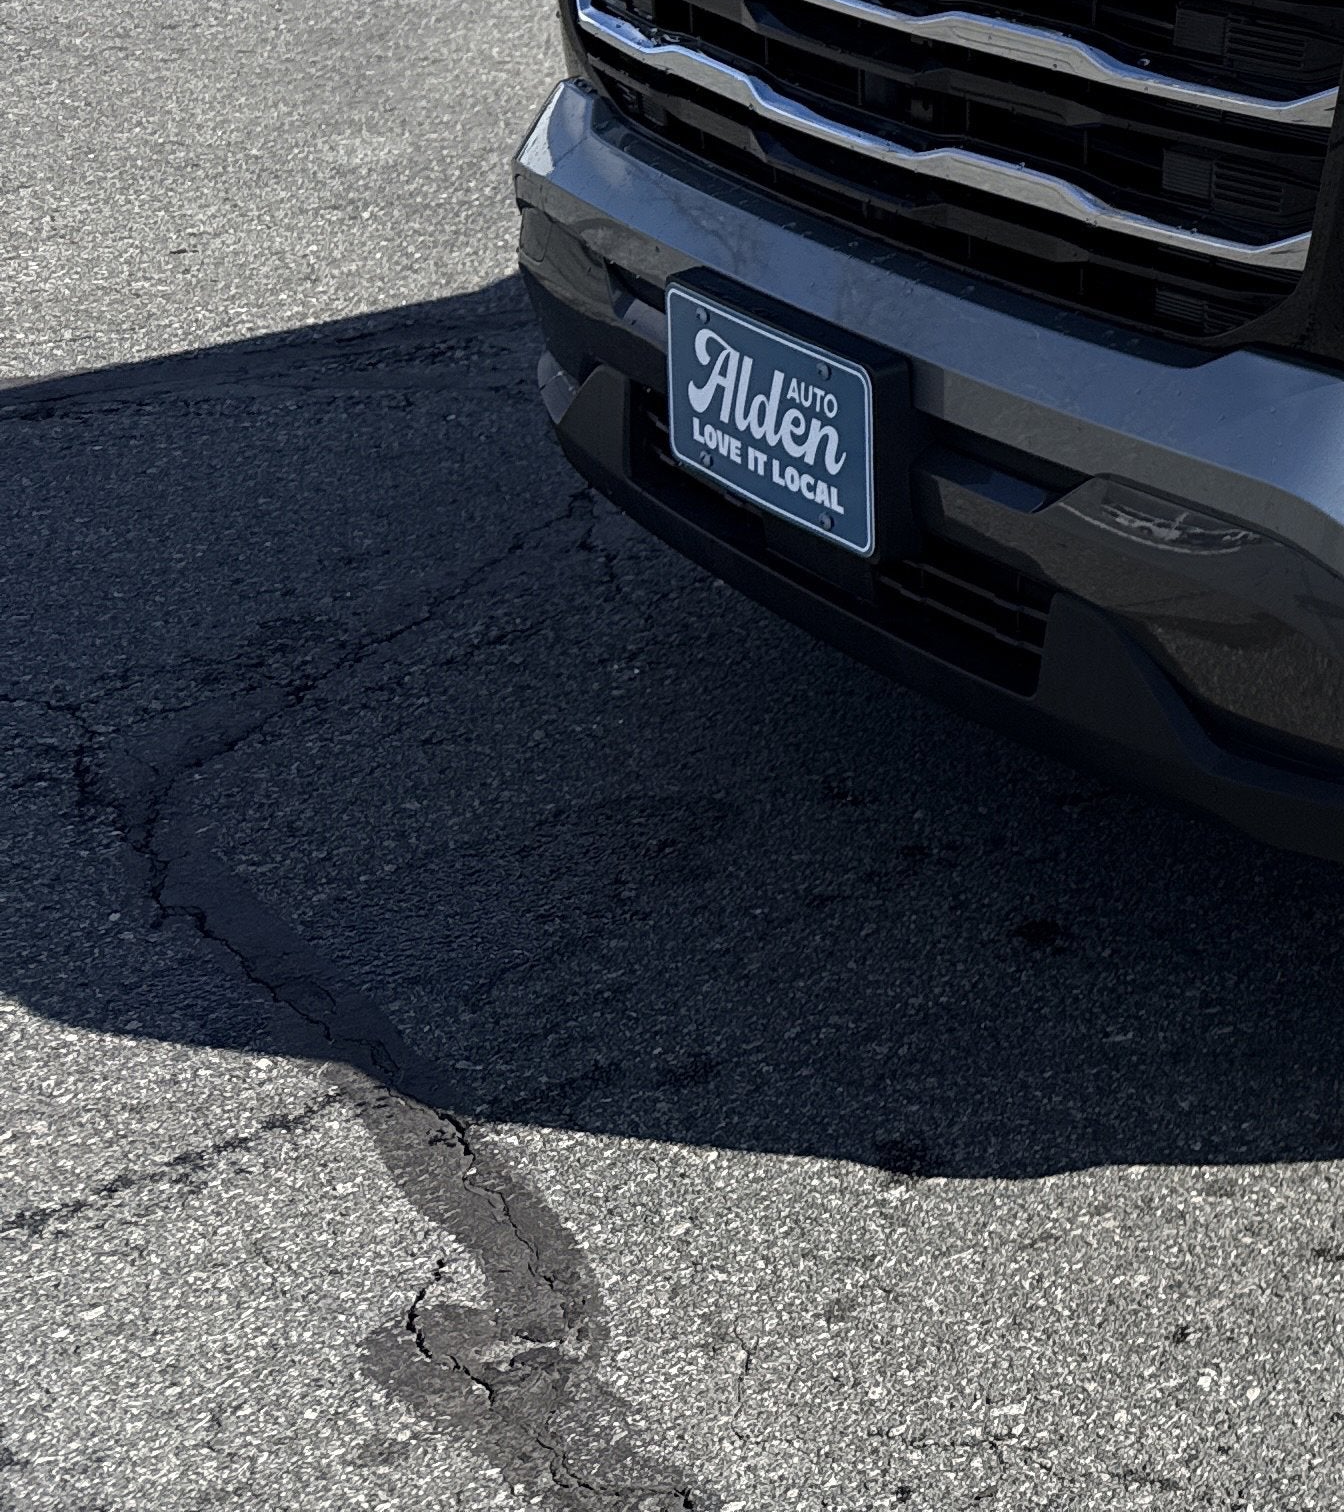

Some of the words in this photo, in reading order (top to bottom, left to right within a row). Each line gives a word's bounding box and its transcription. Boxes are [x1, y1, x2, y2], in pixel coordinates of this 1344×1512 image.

[687, 328, 847, 476] Alden
[786, 378, 838, 418] AUTO
[692, 417, 742, 464] LOVE
[747, 445, 768, 476] IT
[772, 459, 845, 515] LOCAL
